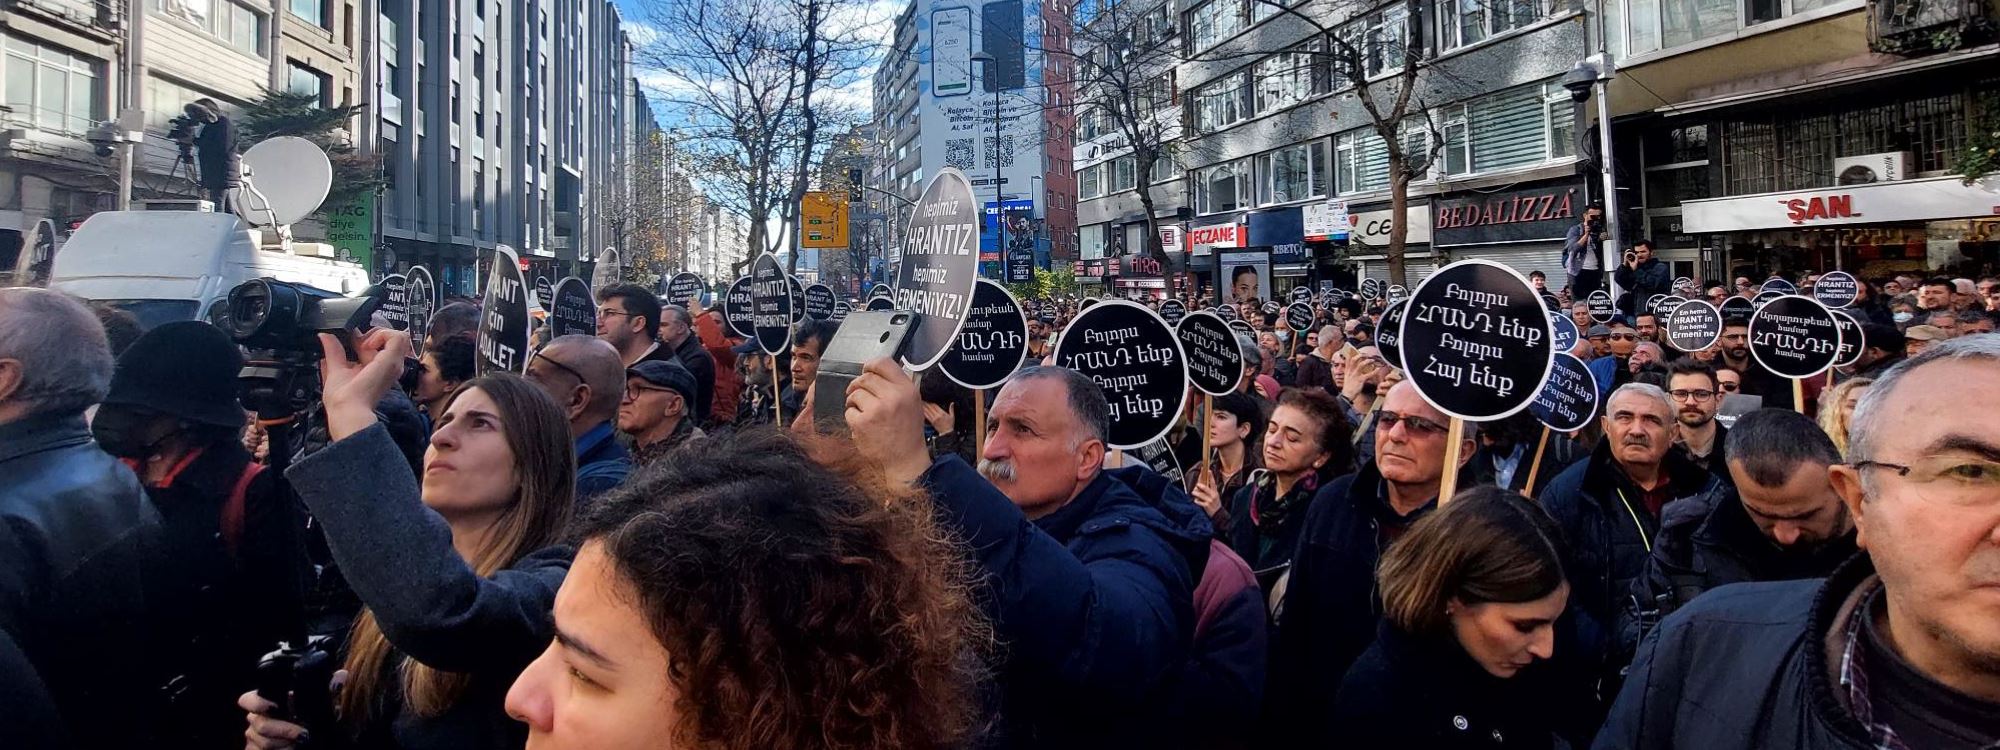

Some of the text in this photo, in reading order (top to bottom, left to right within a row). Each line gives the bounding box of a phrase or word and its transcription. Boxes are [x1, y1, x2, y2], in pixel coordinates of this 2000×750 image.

[983, 100, 1009, 108] Kolaca
[1884, 155, 1895, 181] rçelik
[923, 196, 959, 221] hepimiz
[1434, 191, 1576, 229] BEDALİZZA
[1780, 194, 1858, 225] ŞAN
[907, 223, 973, 256] HRANTIZ
[1193, 226, 1235, 245] ECZANE
[1272, 241, 1303, 256] RBETÇİ
[912, 263, 948, 287] hepimiz
[753, 279, 787, 298] HRANTIZ
[1444, 283, 1509, 310] Բոլորս
[968, 303, 1014, 318] րութեան
[1673, 315, 1703, 325] HRANT
[1415, 303, 1494, 333] ՀՐԱՆԴ
[1498, 316, 1542, 348] ենք
[479, 331, 516, 371] ADALET
[951, 331, 1022, 350] ԱՆԴԻ
[1181, 329, 1219, 352] ՀՐԱՆԴ
[1438, 332, 1504, 361] Բոլորս
[1753, 330, 1835, 354] ՀՐԱՆԴԻ
[1135, 343, 1174, 366] ենք
[1423, 353, 1515, 397] Հայ ենք
[1123, 394, 1163, 418] ենք
